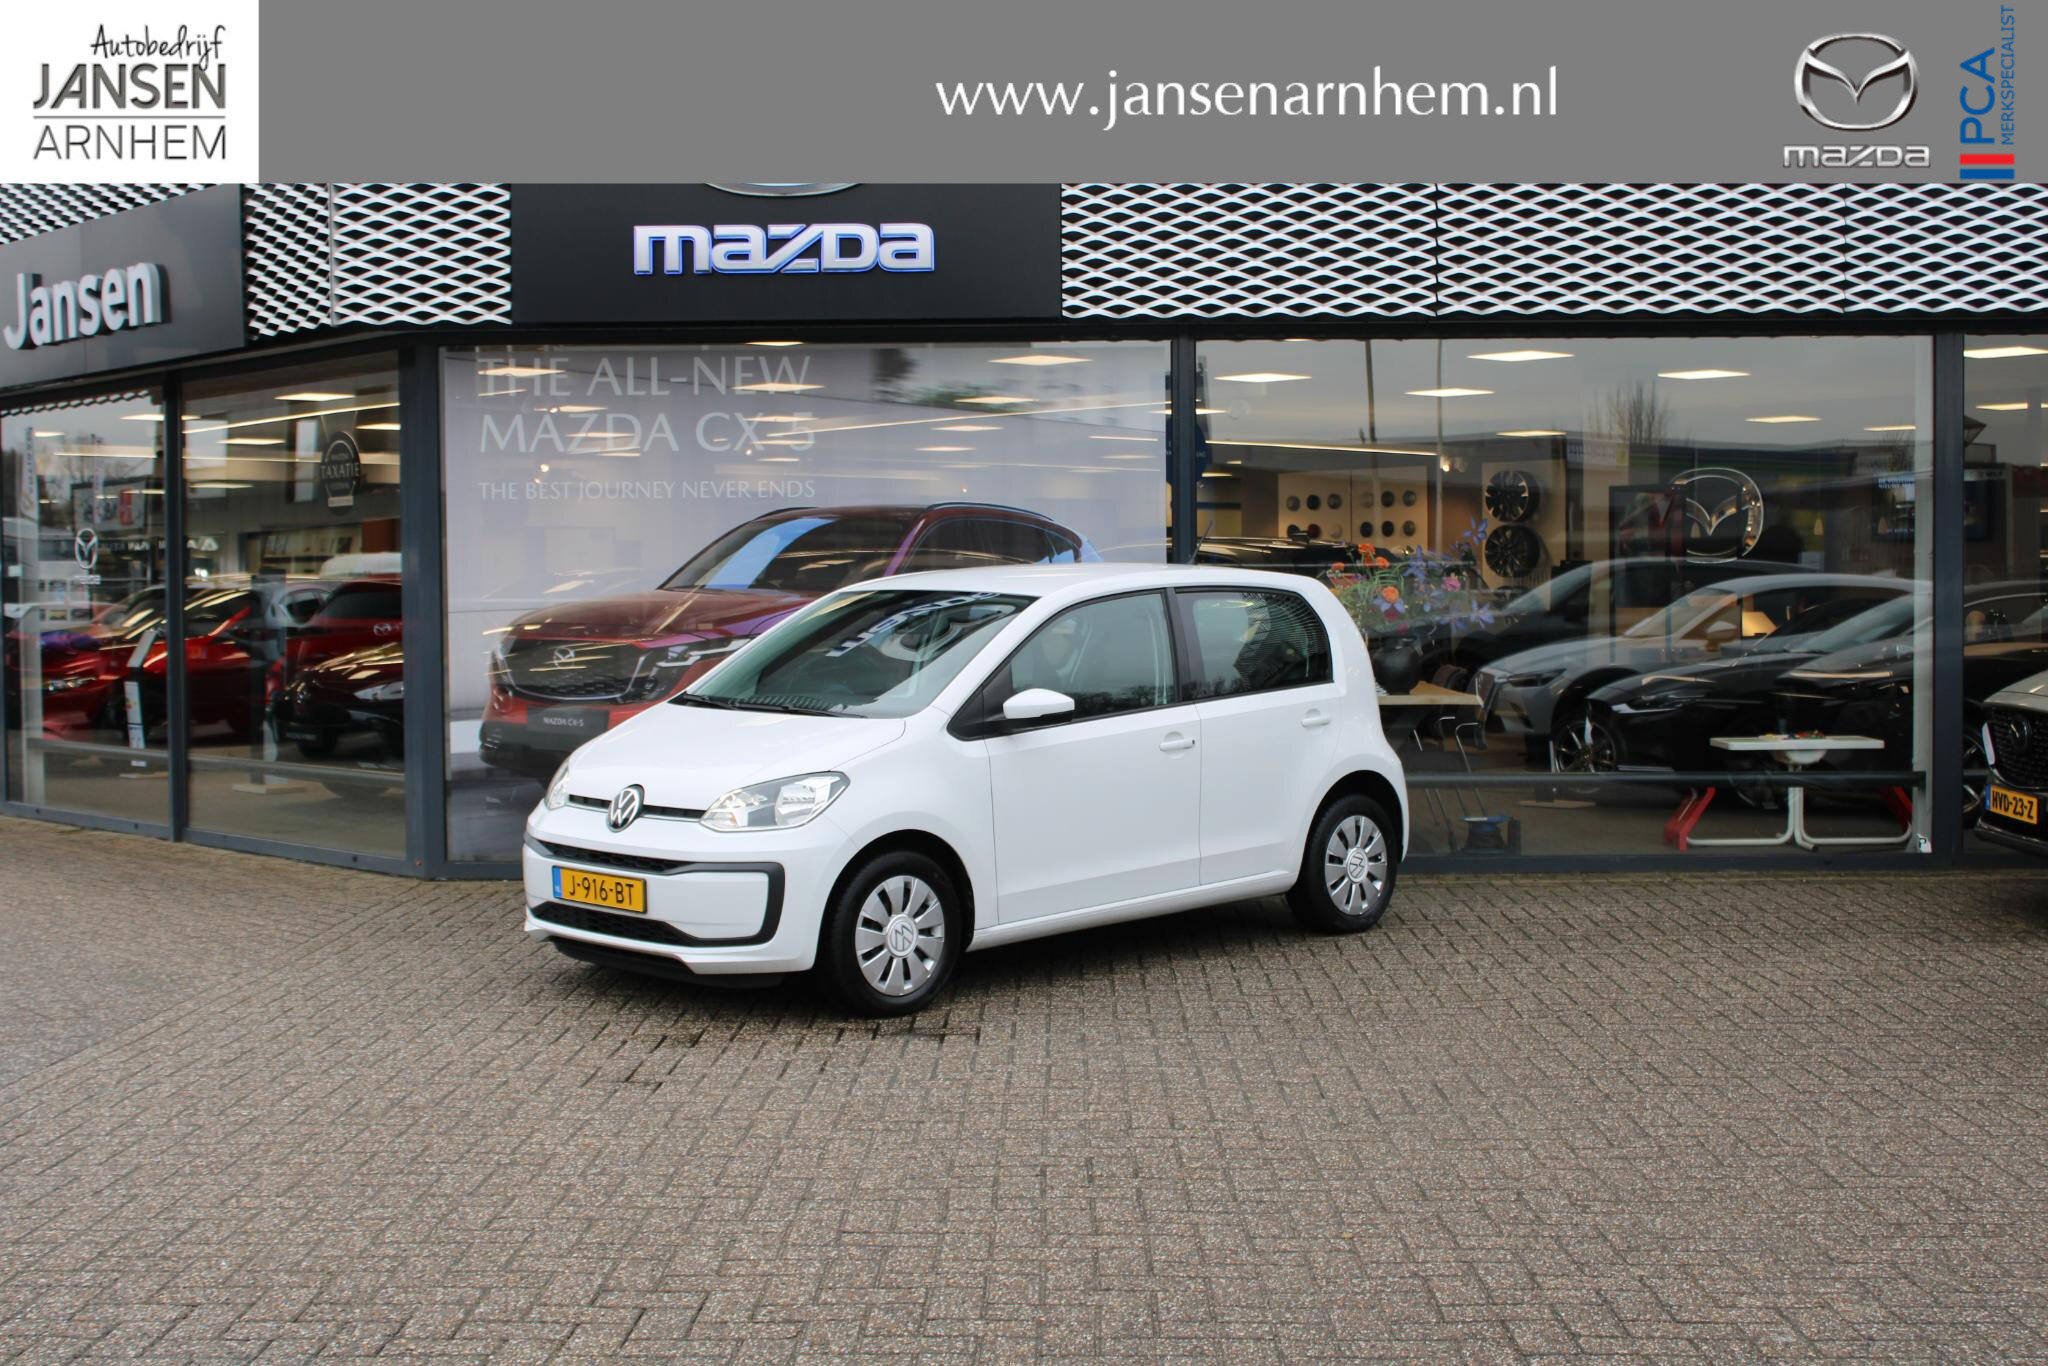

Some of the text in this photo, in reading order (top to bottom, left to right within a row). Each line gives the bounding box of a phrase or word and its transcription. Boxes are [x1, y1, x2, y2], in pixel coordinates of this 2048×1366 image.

[633, 223, 935, 275] mazda
[3, 262, 163, 350] Jansen
[478, 356, 812, 397] THE ALL-NEW
[480, 413, 680, 453] MAZDA
[478, 479, 816, 501] THE BEST JOURNEY NEVER ENDS
[543, 716, 567, 726] MAZDA
[1991, 790, 2034, 820] HVD-23-Z
[569, 875, 634, 905] J-916-BT
